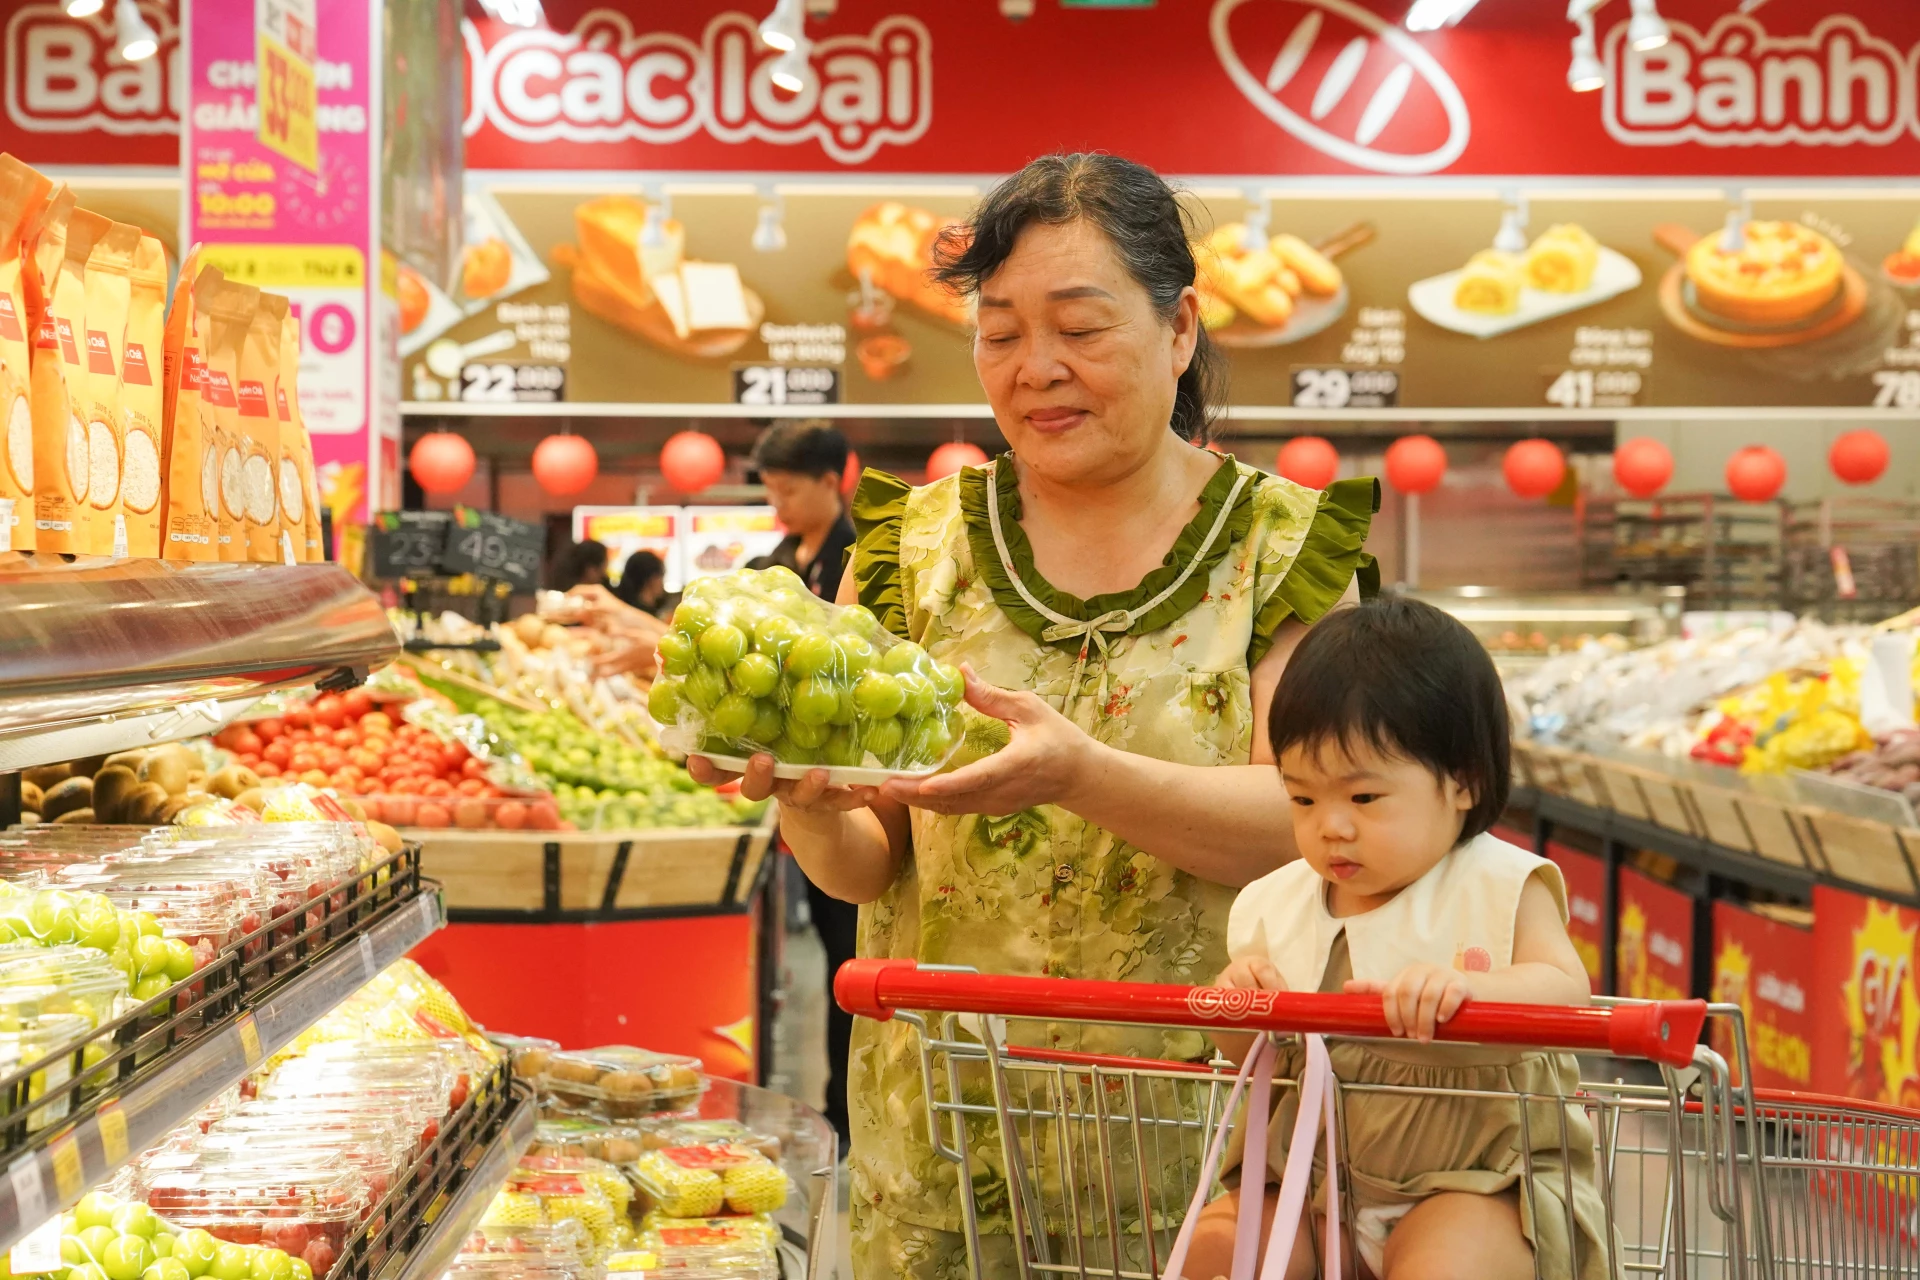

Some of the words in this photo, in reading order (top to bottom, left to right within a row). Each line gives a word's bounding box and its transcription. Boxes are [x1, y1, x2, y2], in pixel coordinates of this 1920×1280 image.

[498, 28, 687, 123] các
[720, 33, 913, 143] loại
[1622, 33, 1890, 126] Bánh
